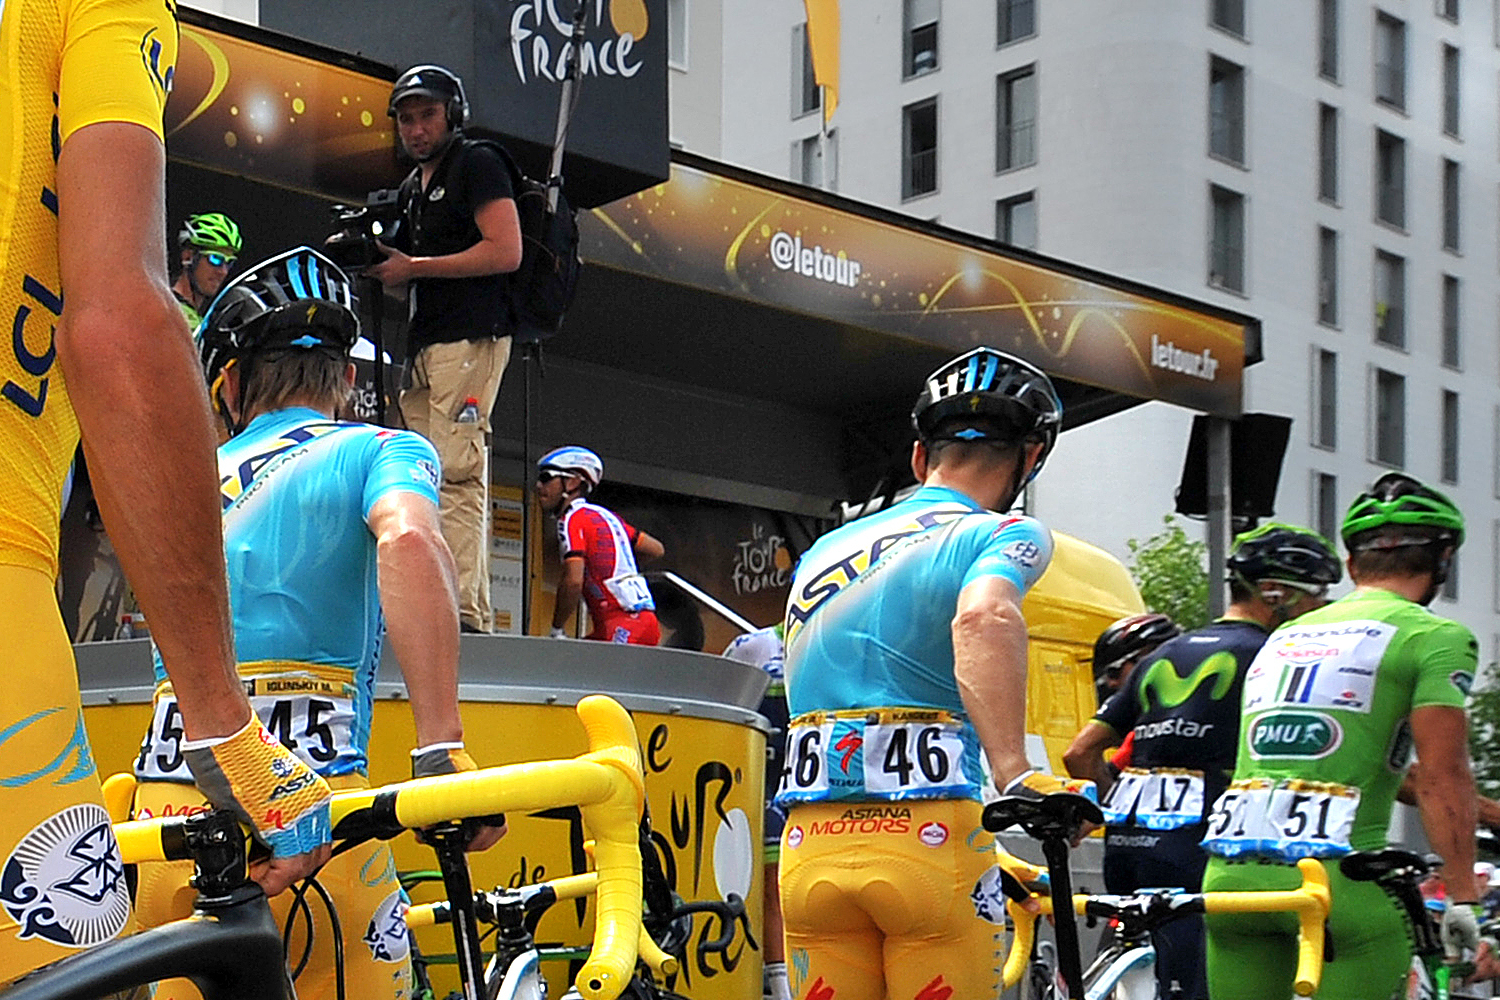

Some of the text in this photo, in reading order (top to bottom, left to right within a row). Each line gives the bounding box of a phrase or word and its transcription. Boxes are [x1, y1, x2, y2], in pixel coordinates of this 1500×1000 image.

[770, 231, 861, 287] @letour
[1151, 334, 1219, 381] letour.fr
[236, 447, 309, 511] PROTEAM
[267, 699, 338, 762] 45
[1134, 717, 1214, 741] movistar
[1253, 724, 1301, 746] PMU
[882, 726, 950, 787] 46
[841, 807, 912, 820] ASTANA
[1156, 777, 1192, 812] 17
[1283, 794, 1332, 840] 51
[810, 818, 912, 836] MOTORS
